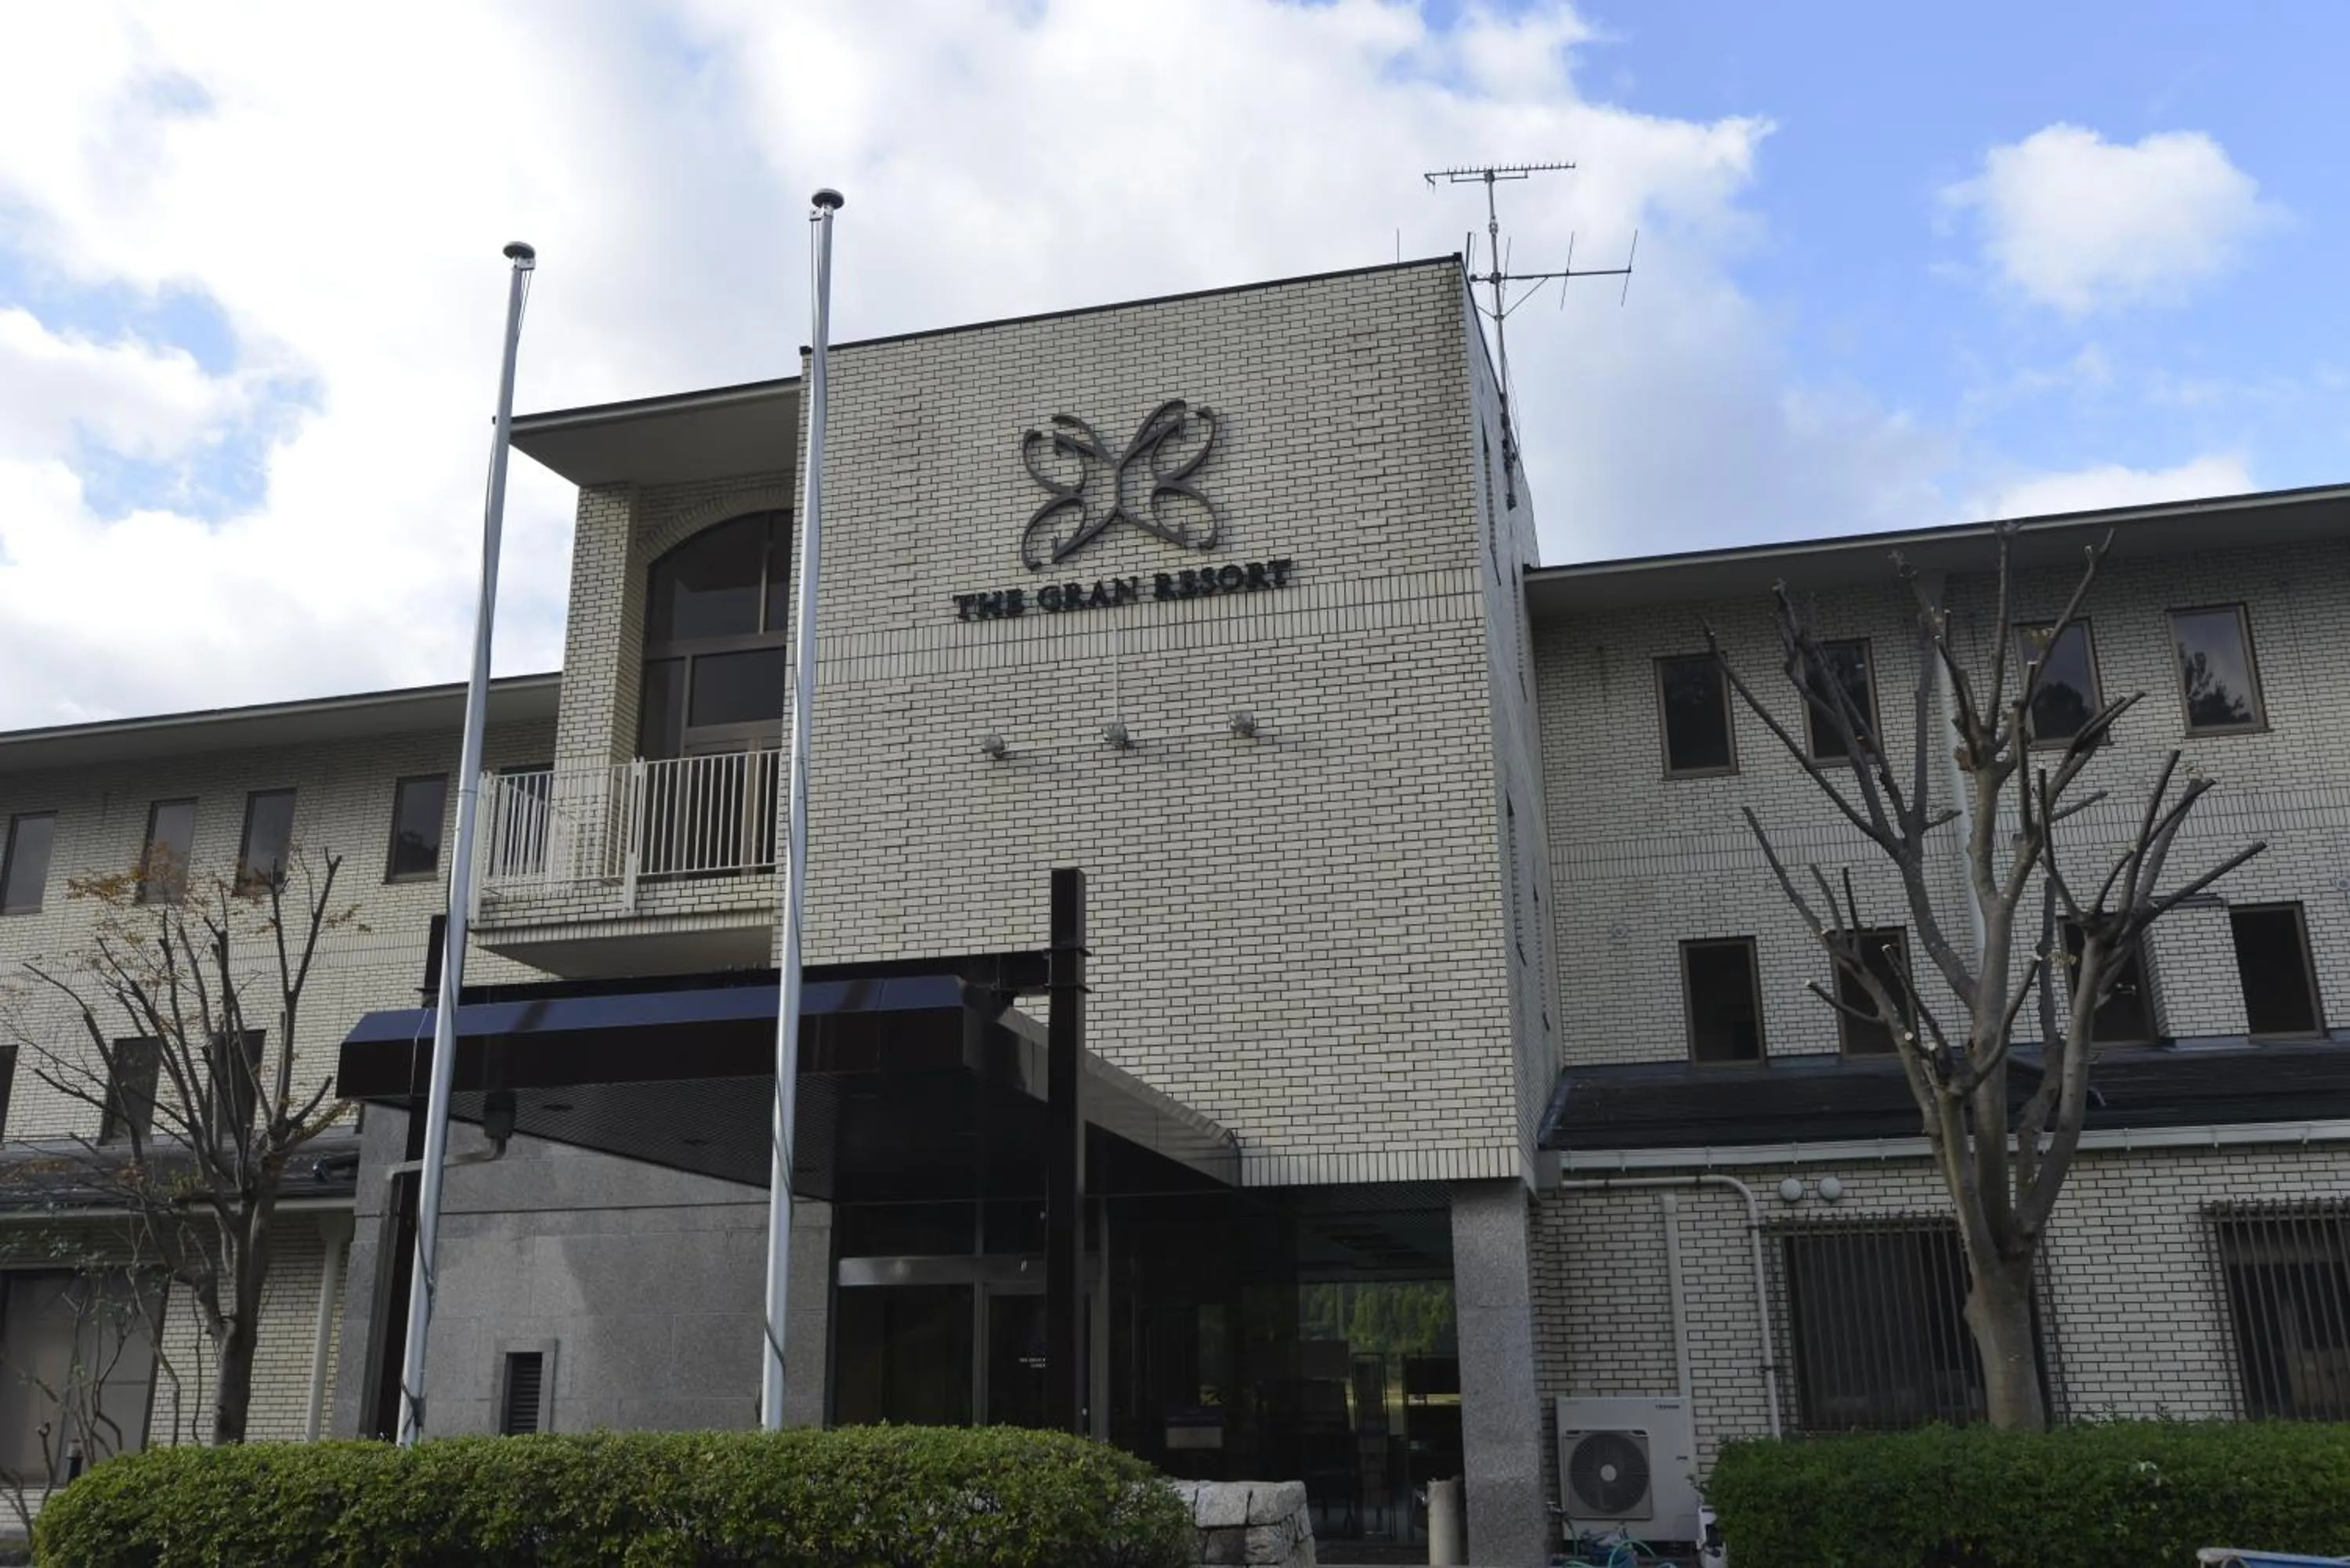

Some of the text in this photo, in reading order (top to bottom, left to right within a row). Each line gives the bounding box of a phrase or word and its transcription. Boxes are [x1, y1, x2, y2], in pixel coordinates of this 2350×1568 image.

[953, 558, 1292, 622] THE GRAN RESORT
